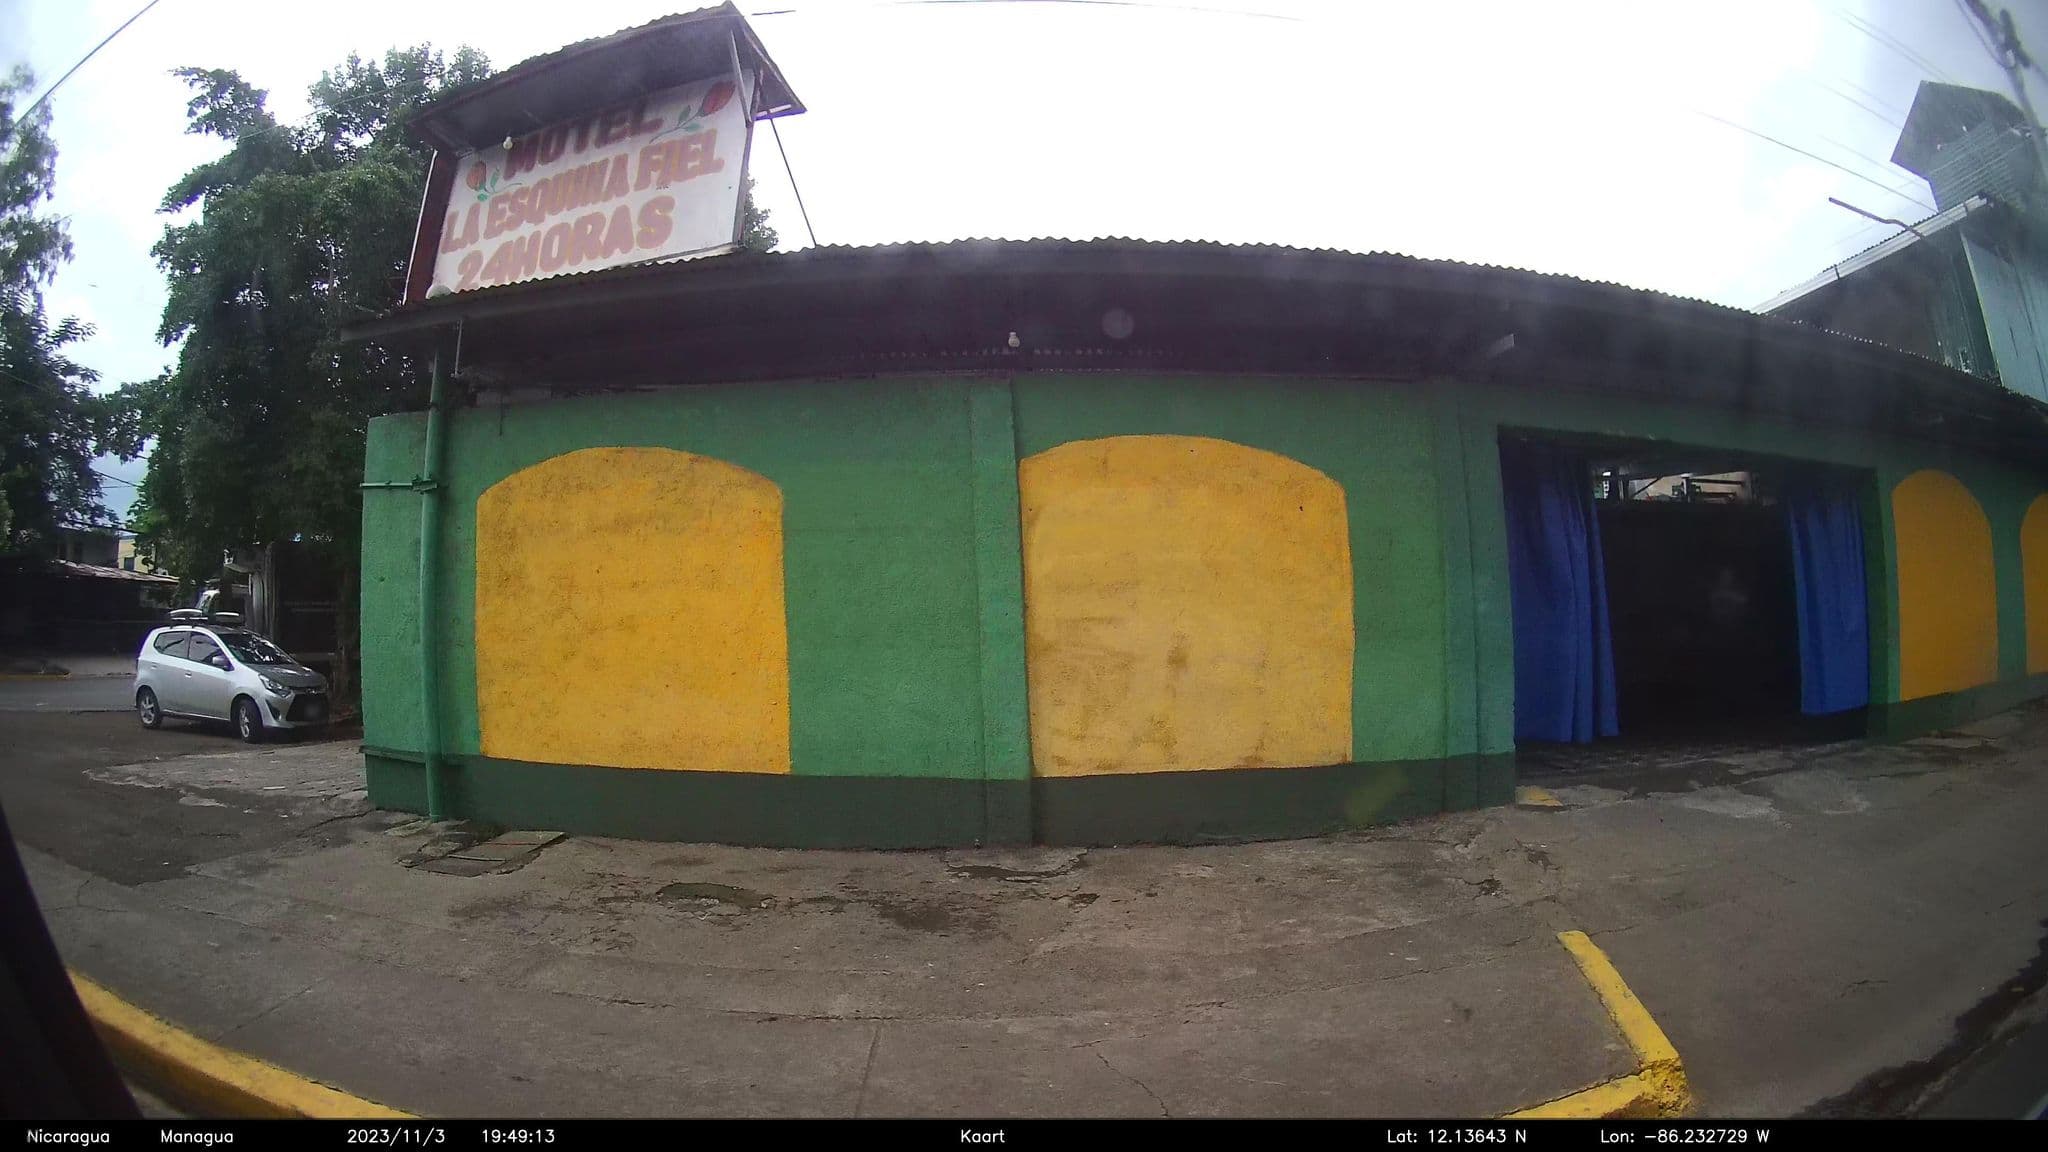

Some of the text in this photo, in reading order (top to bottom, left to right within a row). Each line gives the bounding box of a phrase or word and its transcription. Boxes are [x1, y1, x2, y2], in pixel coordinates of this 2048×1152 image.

[441, 203, 480, 254] LA
[634, 128, 725, 192] FIEL
[504, 101, 665, 181] MOTEL
